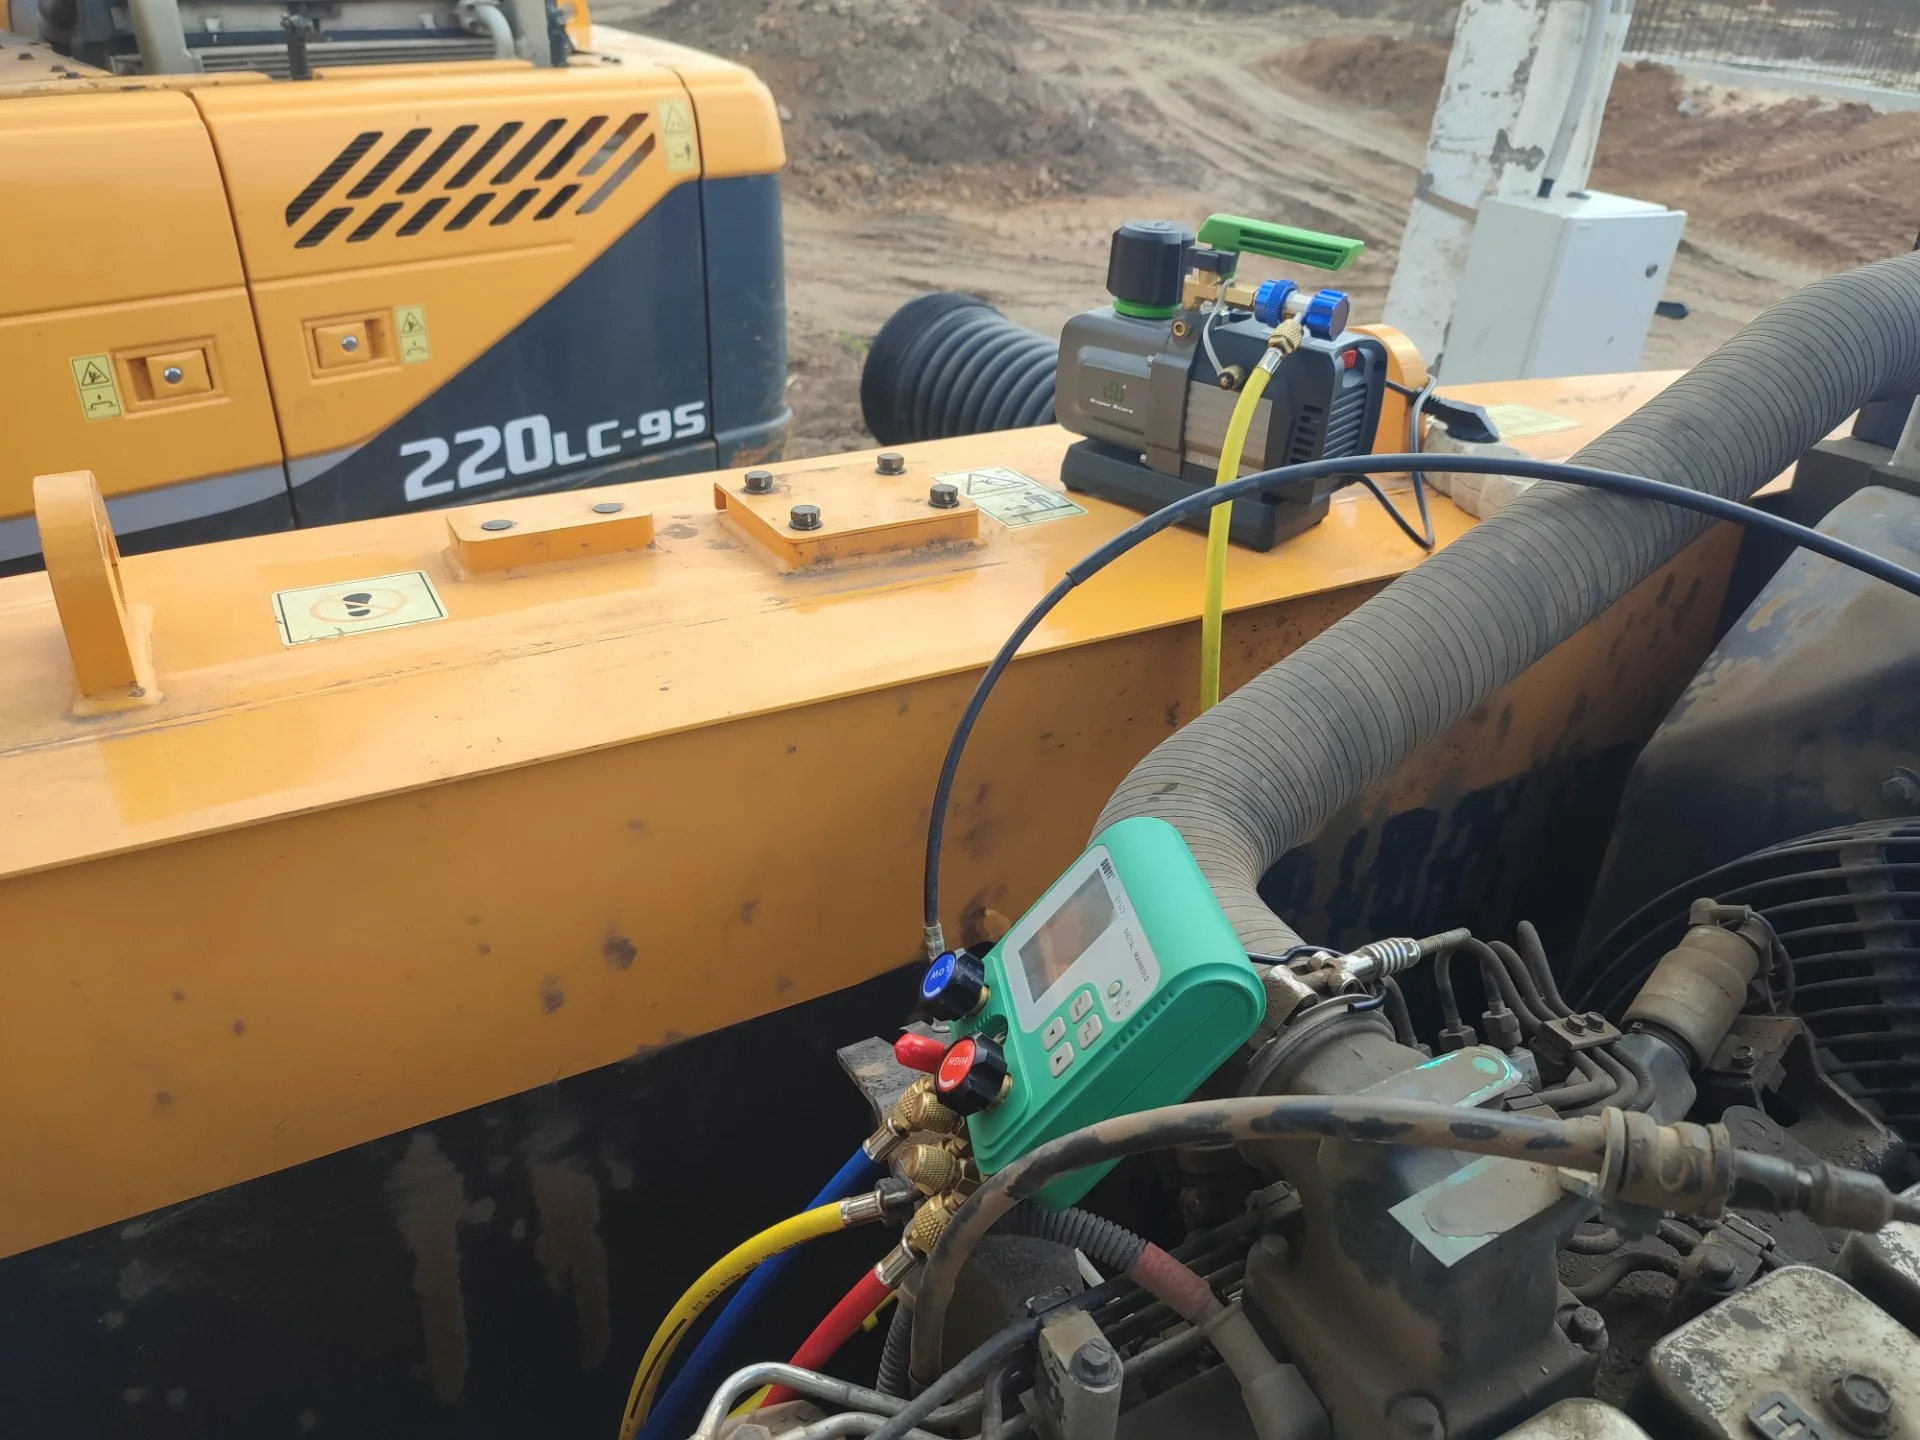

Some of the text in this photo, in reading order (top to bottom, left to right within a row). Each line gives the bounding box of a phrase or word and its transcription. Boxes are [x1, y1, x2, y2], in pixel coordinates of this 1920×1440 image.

[400, 400, 706, 502] 220LC-9S
[930, 965, 950, 981] LOW
[948, 1056, 969, 1068] HIGH
